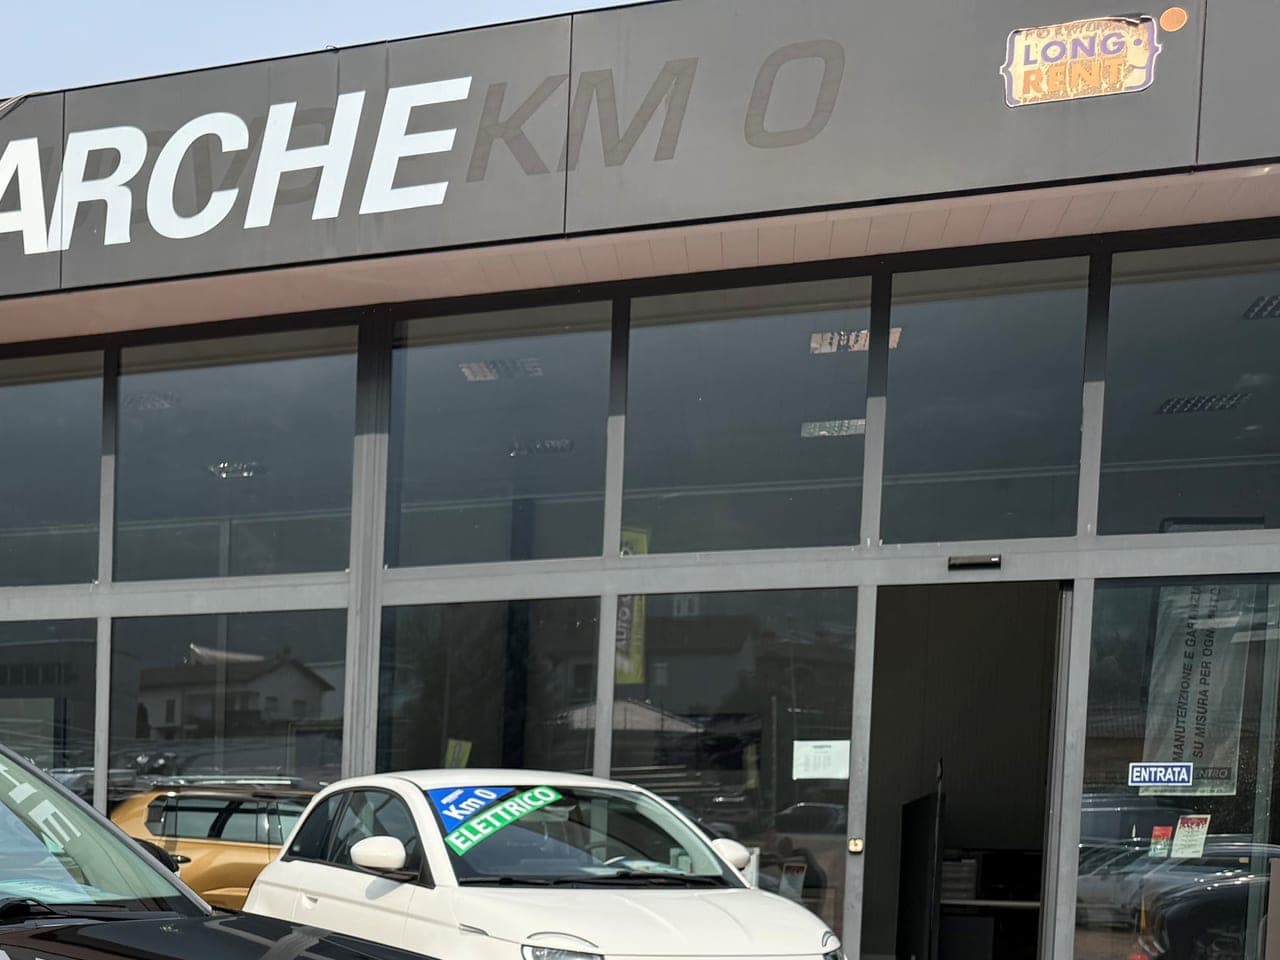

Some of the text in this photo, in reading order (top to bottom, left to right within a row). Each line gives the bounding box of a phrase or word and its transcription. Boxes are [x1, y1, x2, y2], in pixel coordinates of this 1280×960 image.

[1023, 32, 1126, 65] LONG
[1023, 57, 1127, 96] RENT
[465, 57, 699, 183] KM
[1200, 661, 1212, 686] PER
[1173, 662, 1193, 761] MANUTENZIONE
[1195, 689, 1209, 738] MISURA
[1192, 740, 1204, 758] SU
[1133, 767, 1188, 782] ENTRATA
[442, 797, 485, 820] Km
[474, 789, 497, 800] 0
[450, 786, 555, 850] ELETTRICO
